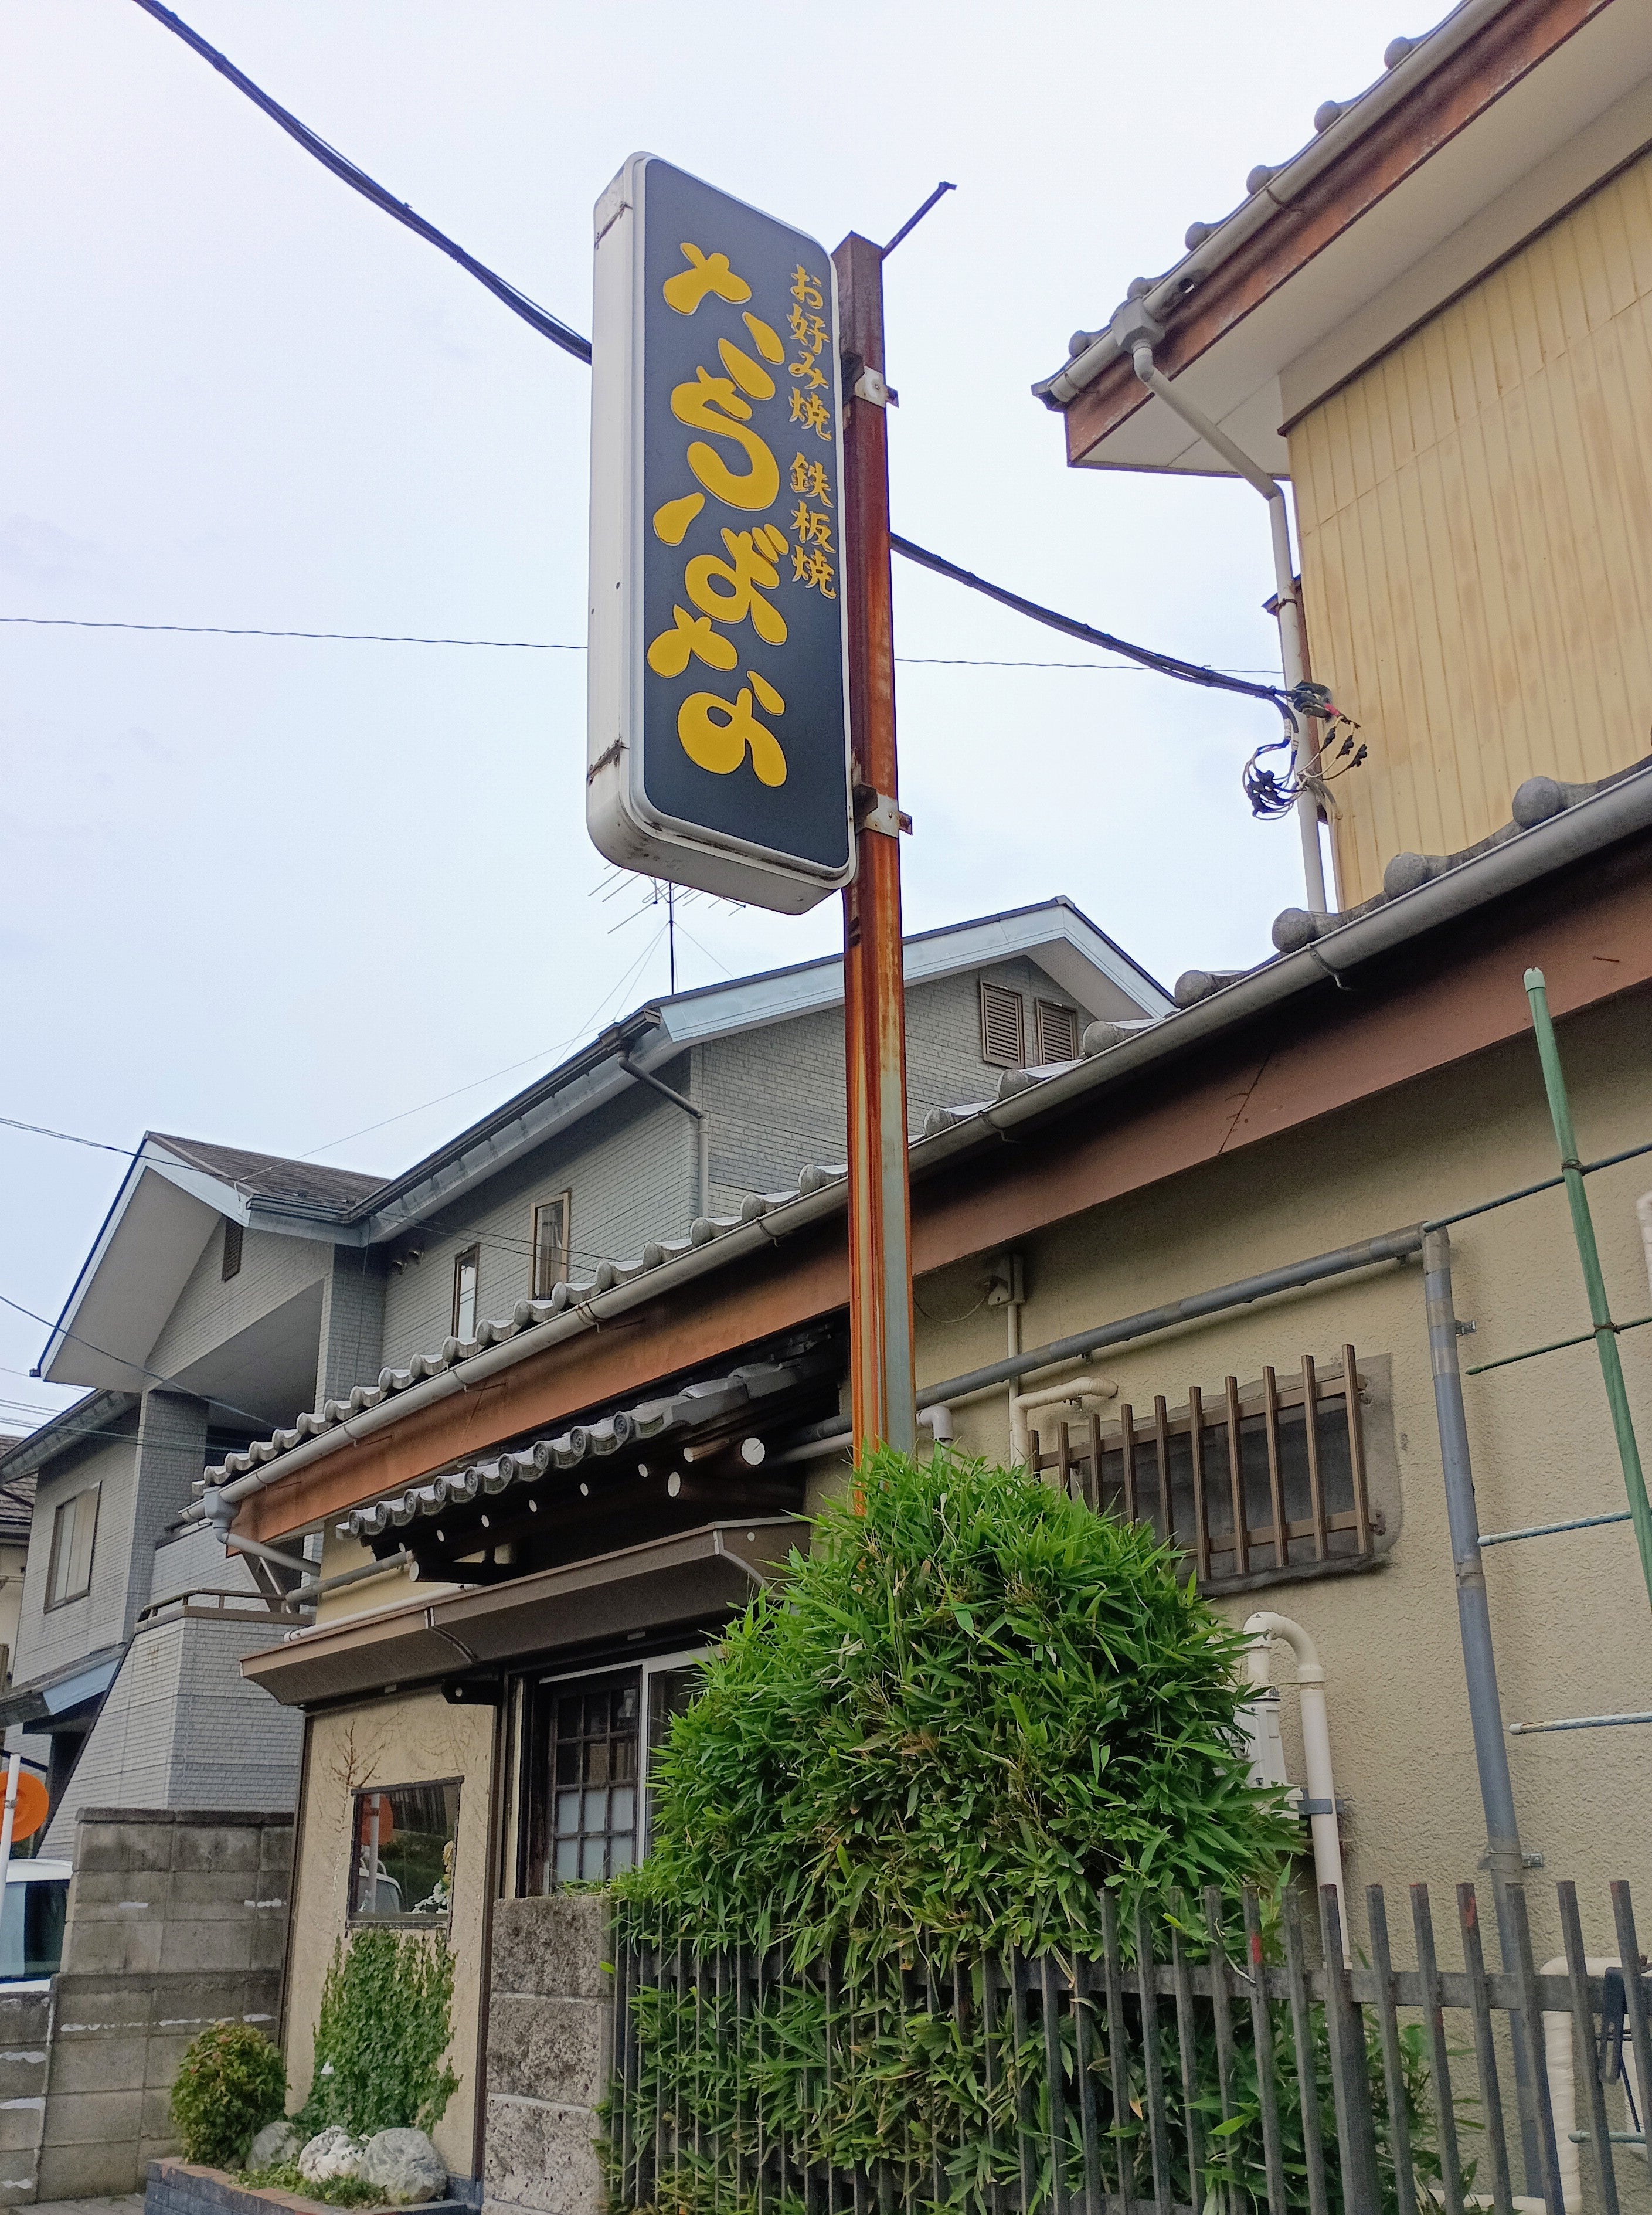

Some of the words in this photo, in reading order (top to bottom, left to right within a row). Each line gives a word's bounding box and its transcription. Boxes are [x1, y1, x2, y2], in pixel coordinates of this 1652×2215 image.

[787, 264, 832, 441] お好み焼
[647, 242, 789, 787] たちばな
[790, 452, 837, 599] 鉄板焼
